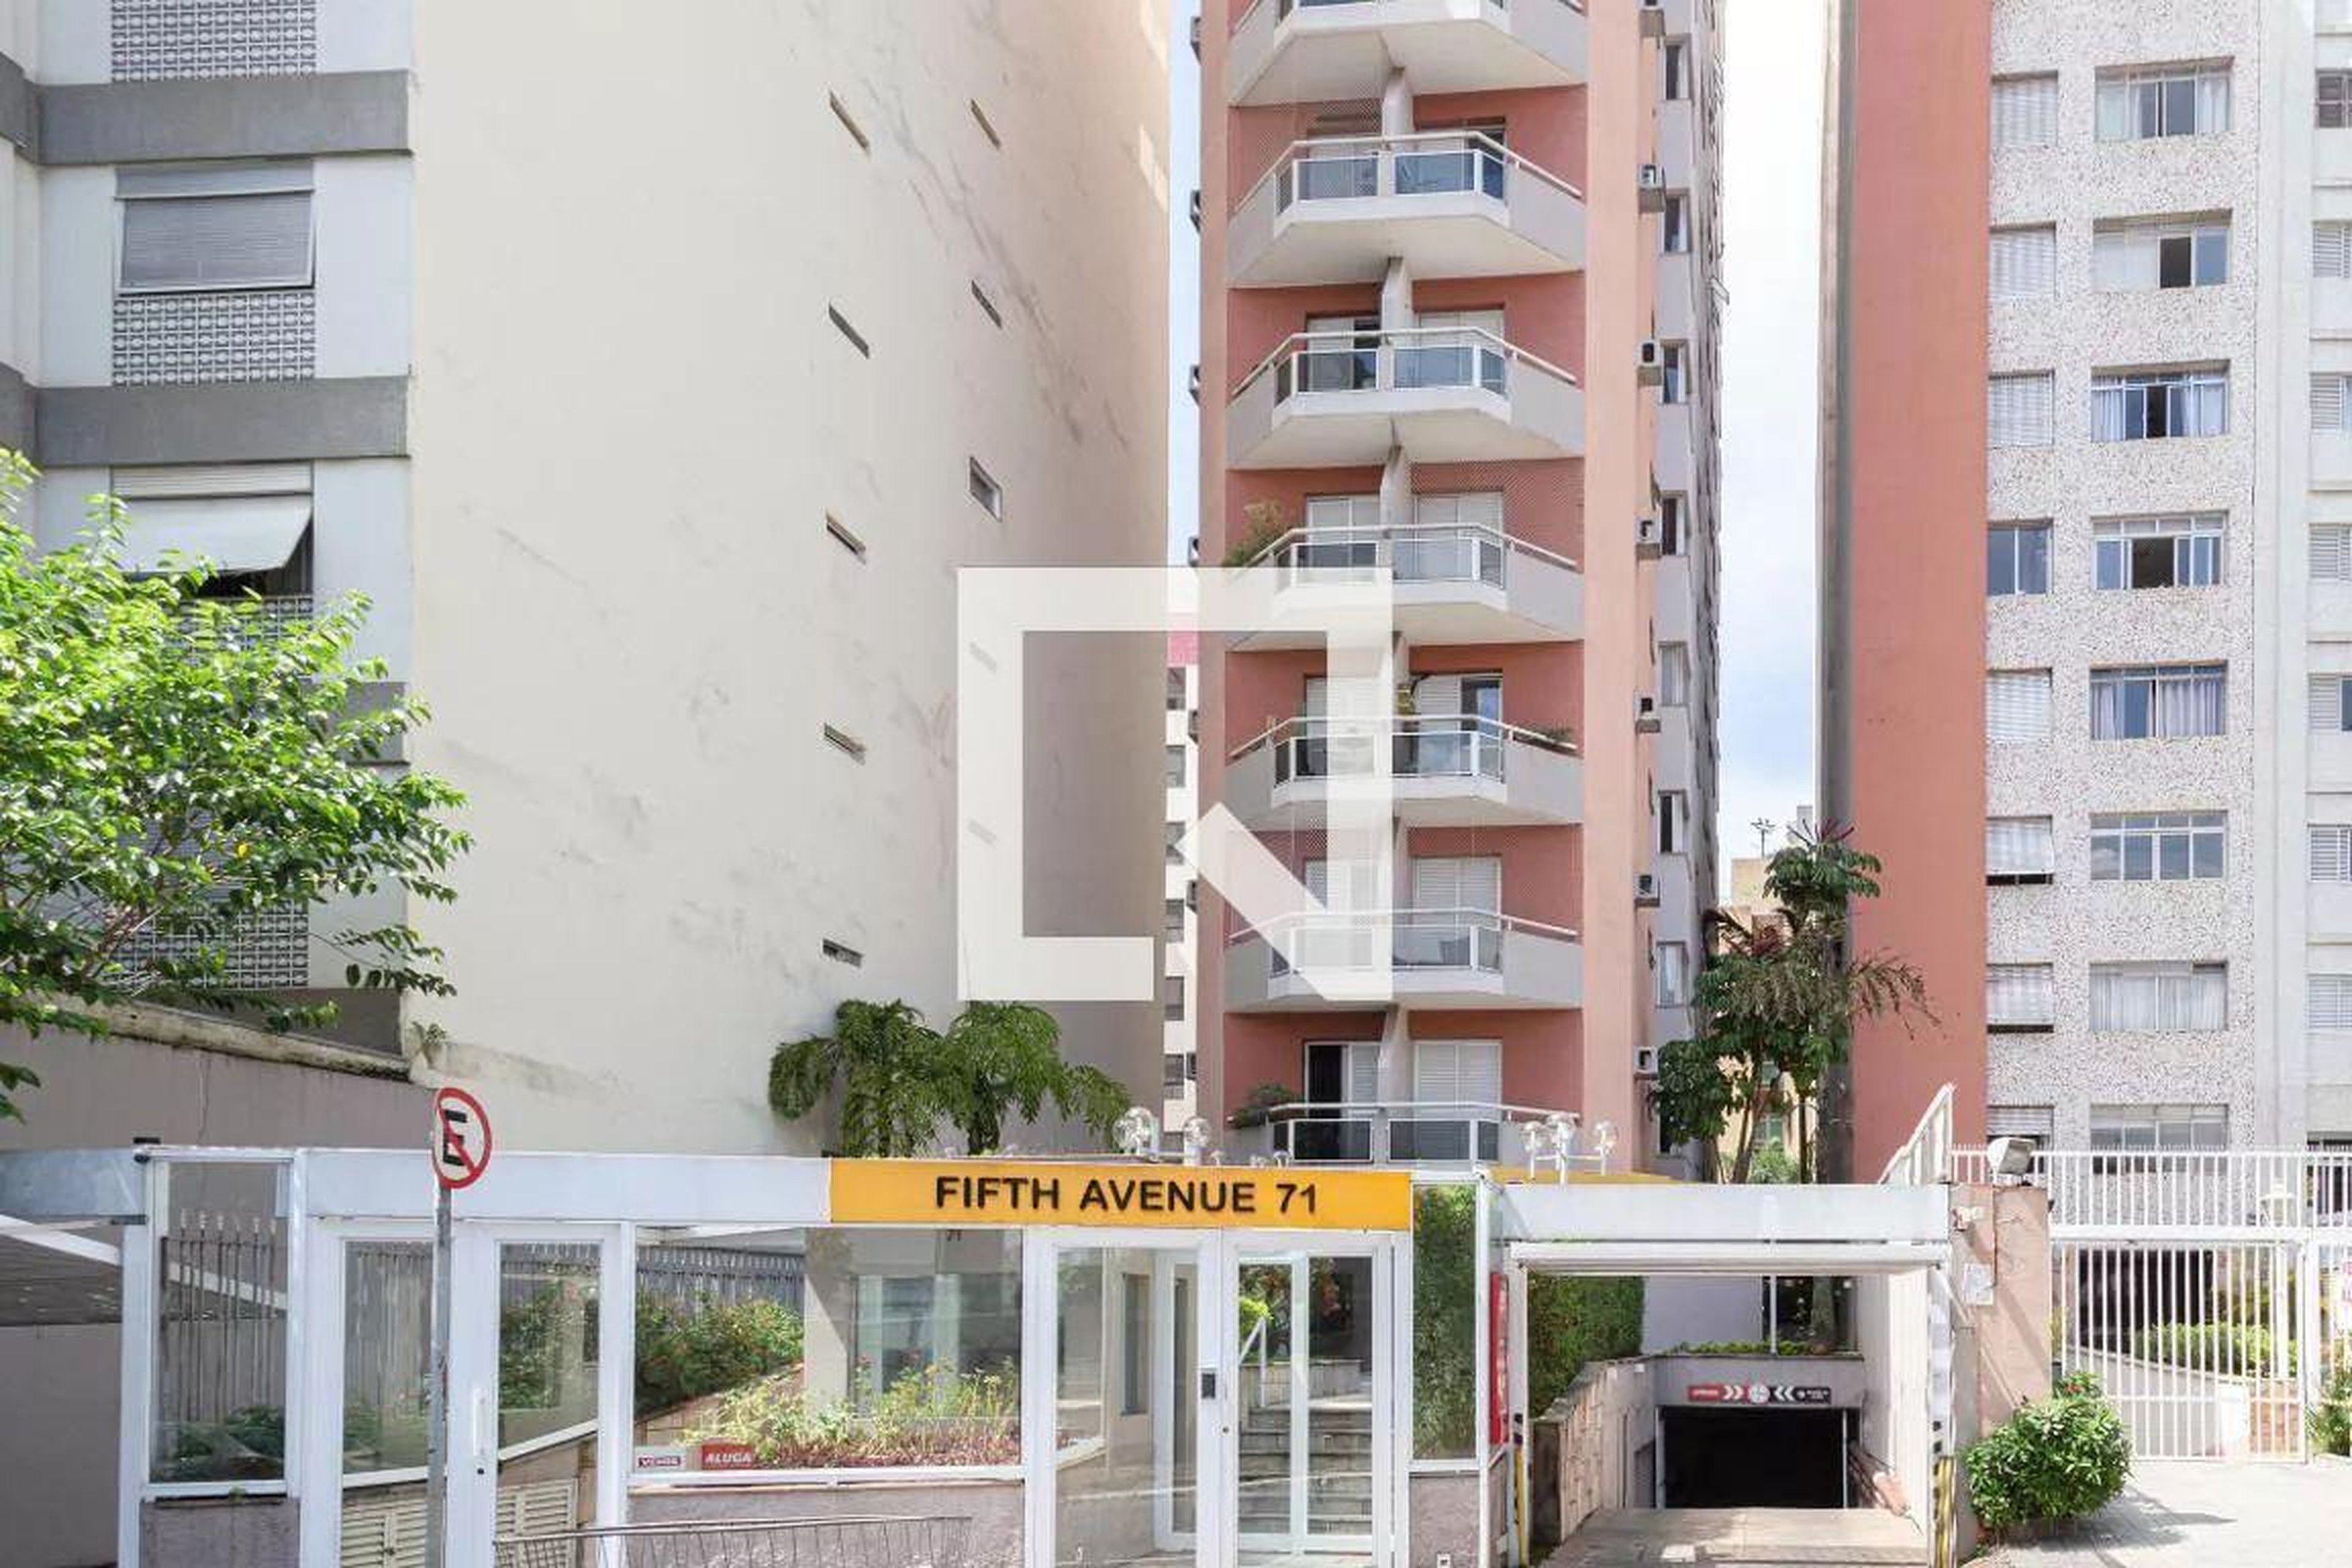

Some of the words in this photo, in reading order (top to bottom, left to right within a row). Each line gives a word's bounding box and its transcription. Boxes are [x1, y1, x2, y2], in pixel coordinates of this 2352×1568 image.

[443, 1109, 468, 1166] E
[936, 1175, 1060, 1210] FIFTH
[1079, 1179, 1256, 1213] AVENUE
[1276, 1183, 1316, 1213] 71
[704, 1452, 752, 1463] ALUGA
